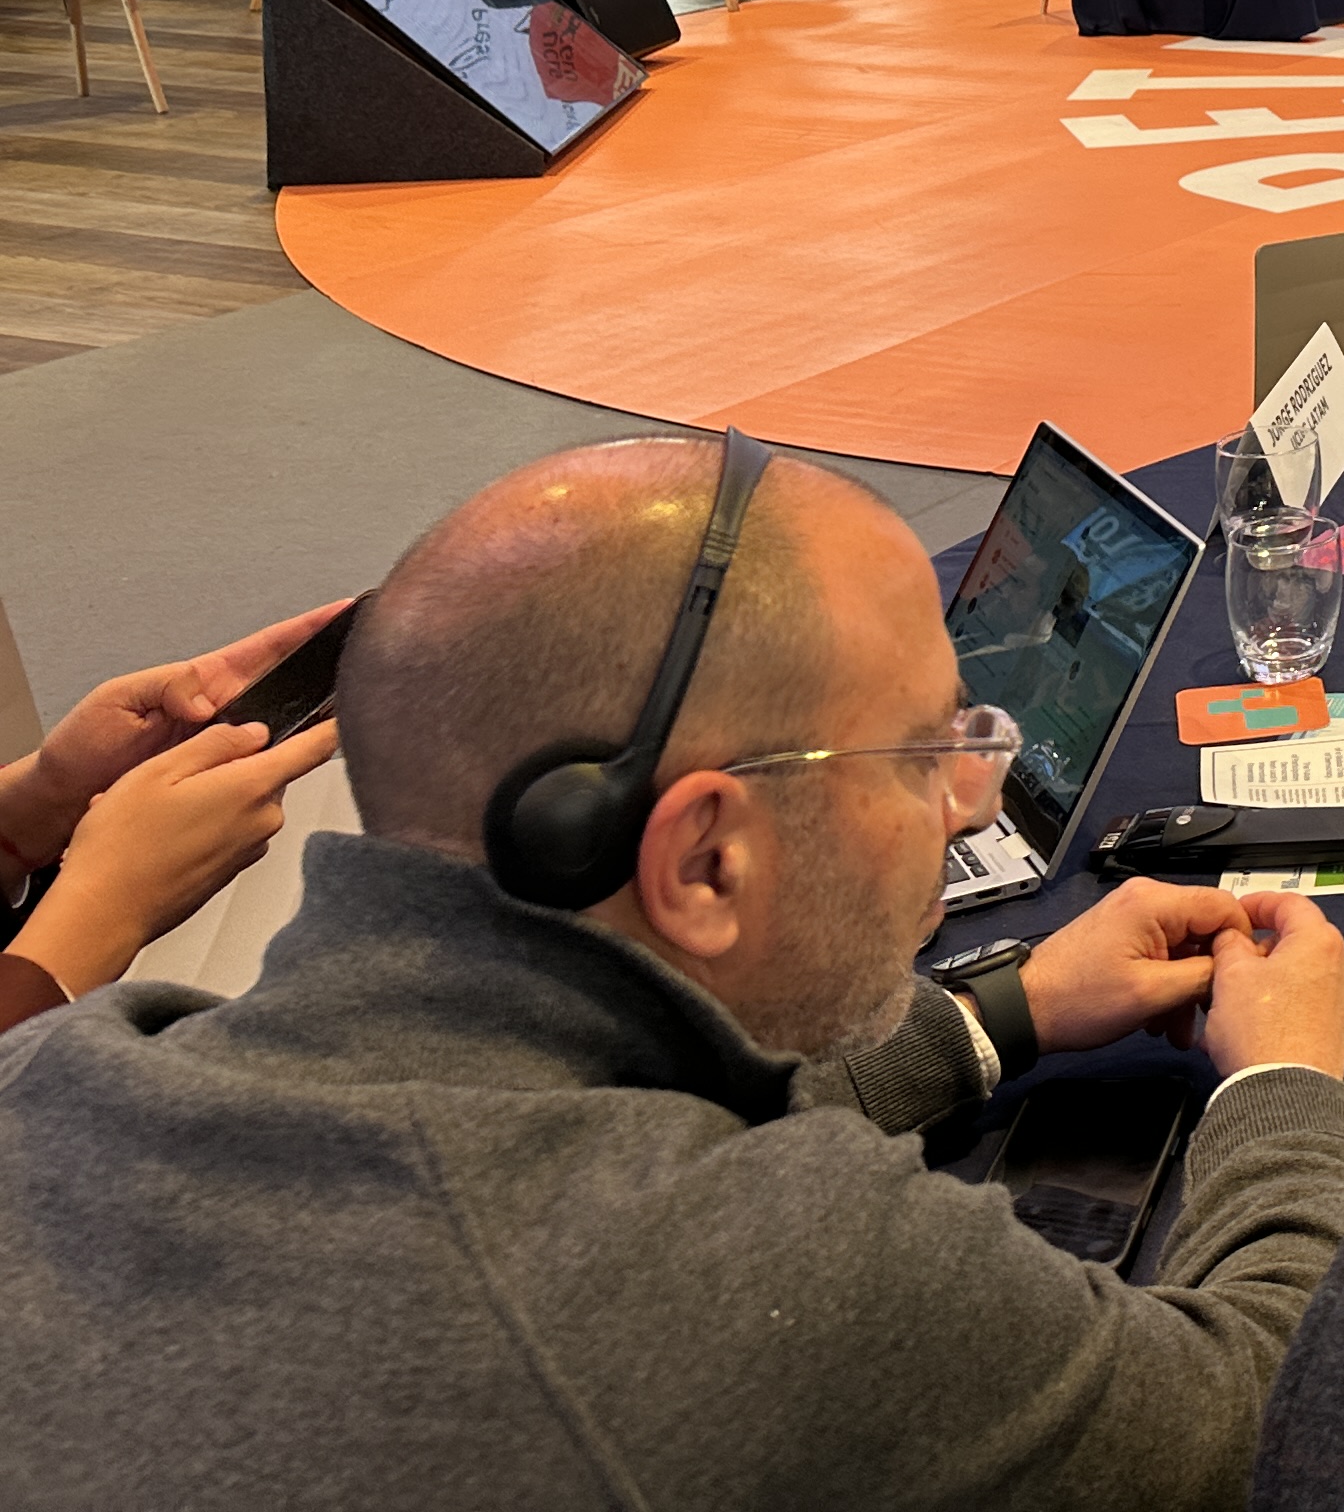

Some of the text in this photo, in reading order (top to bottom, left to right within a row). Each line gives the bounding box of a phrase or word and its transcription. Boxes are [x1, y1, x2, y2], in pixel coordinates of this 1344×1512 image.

[1268, 353, 1333, 448] JORGE RODRIGUEZ
[1307, 396, 1330, 431] LATAM
